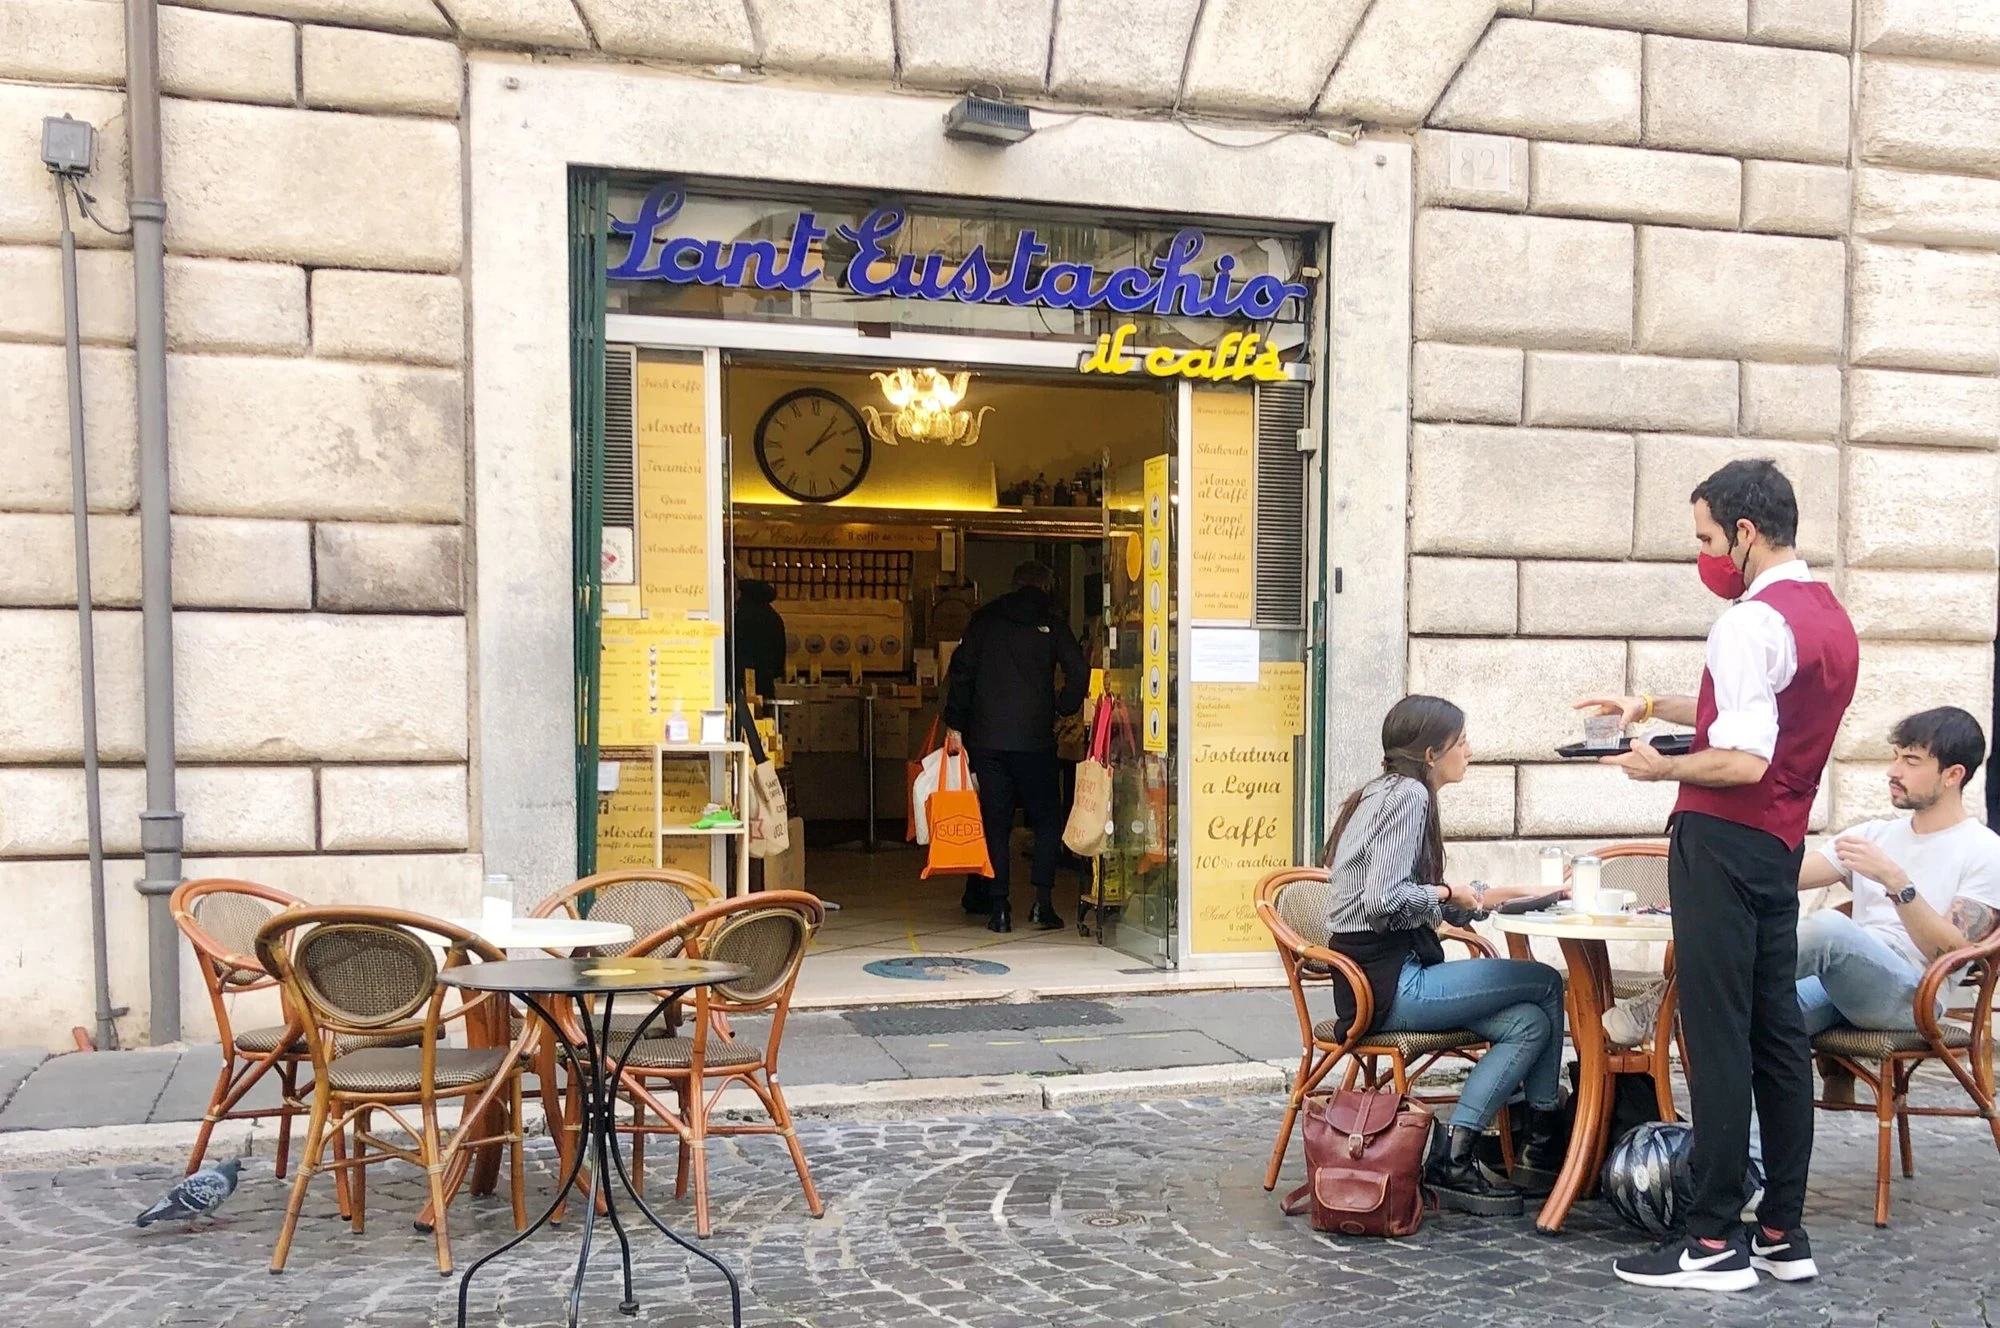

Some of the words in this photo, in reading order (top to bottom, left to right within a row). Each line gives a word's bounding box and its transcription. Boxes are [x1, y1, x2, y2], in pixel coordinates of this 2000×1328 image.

[1460, 148, 1497, 181] 82
[837, 206, 1308, 318] Eustachio
[1080, 323, 1137, 375] il
[1198, 486, 1211, 499] al
[1195, 743, 1290, 763] Tostatura
[1202, 781, 1215, 795] a
[1221, 774, 1282, 800] Legna
[1207, 815, 1279, 847] Caffé
[1196, 855, 1233, 870] 100%
[1236, 854, 1289, 869] arabica
